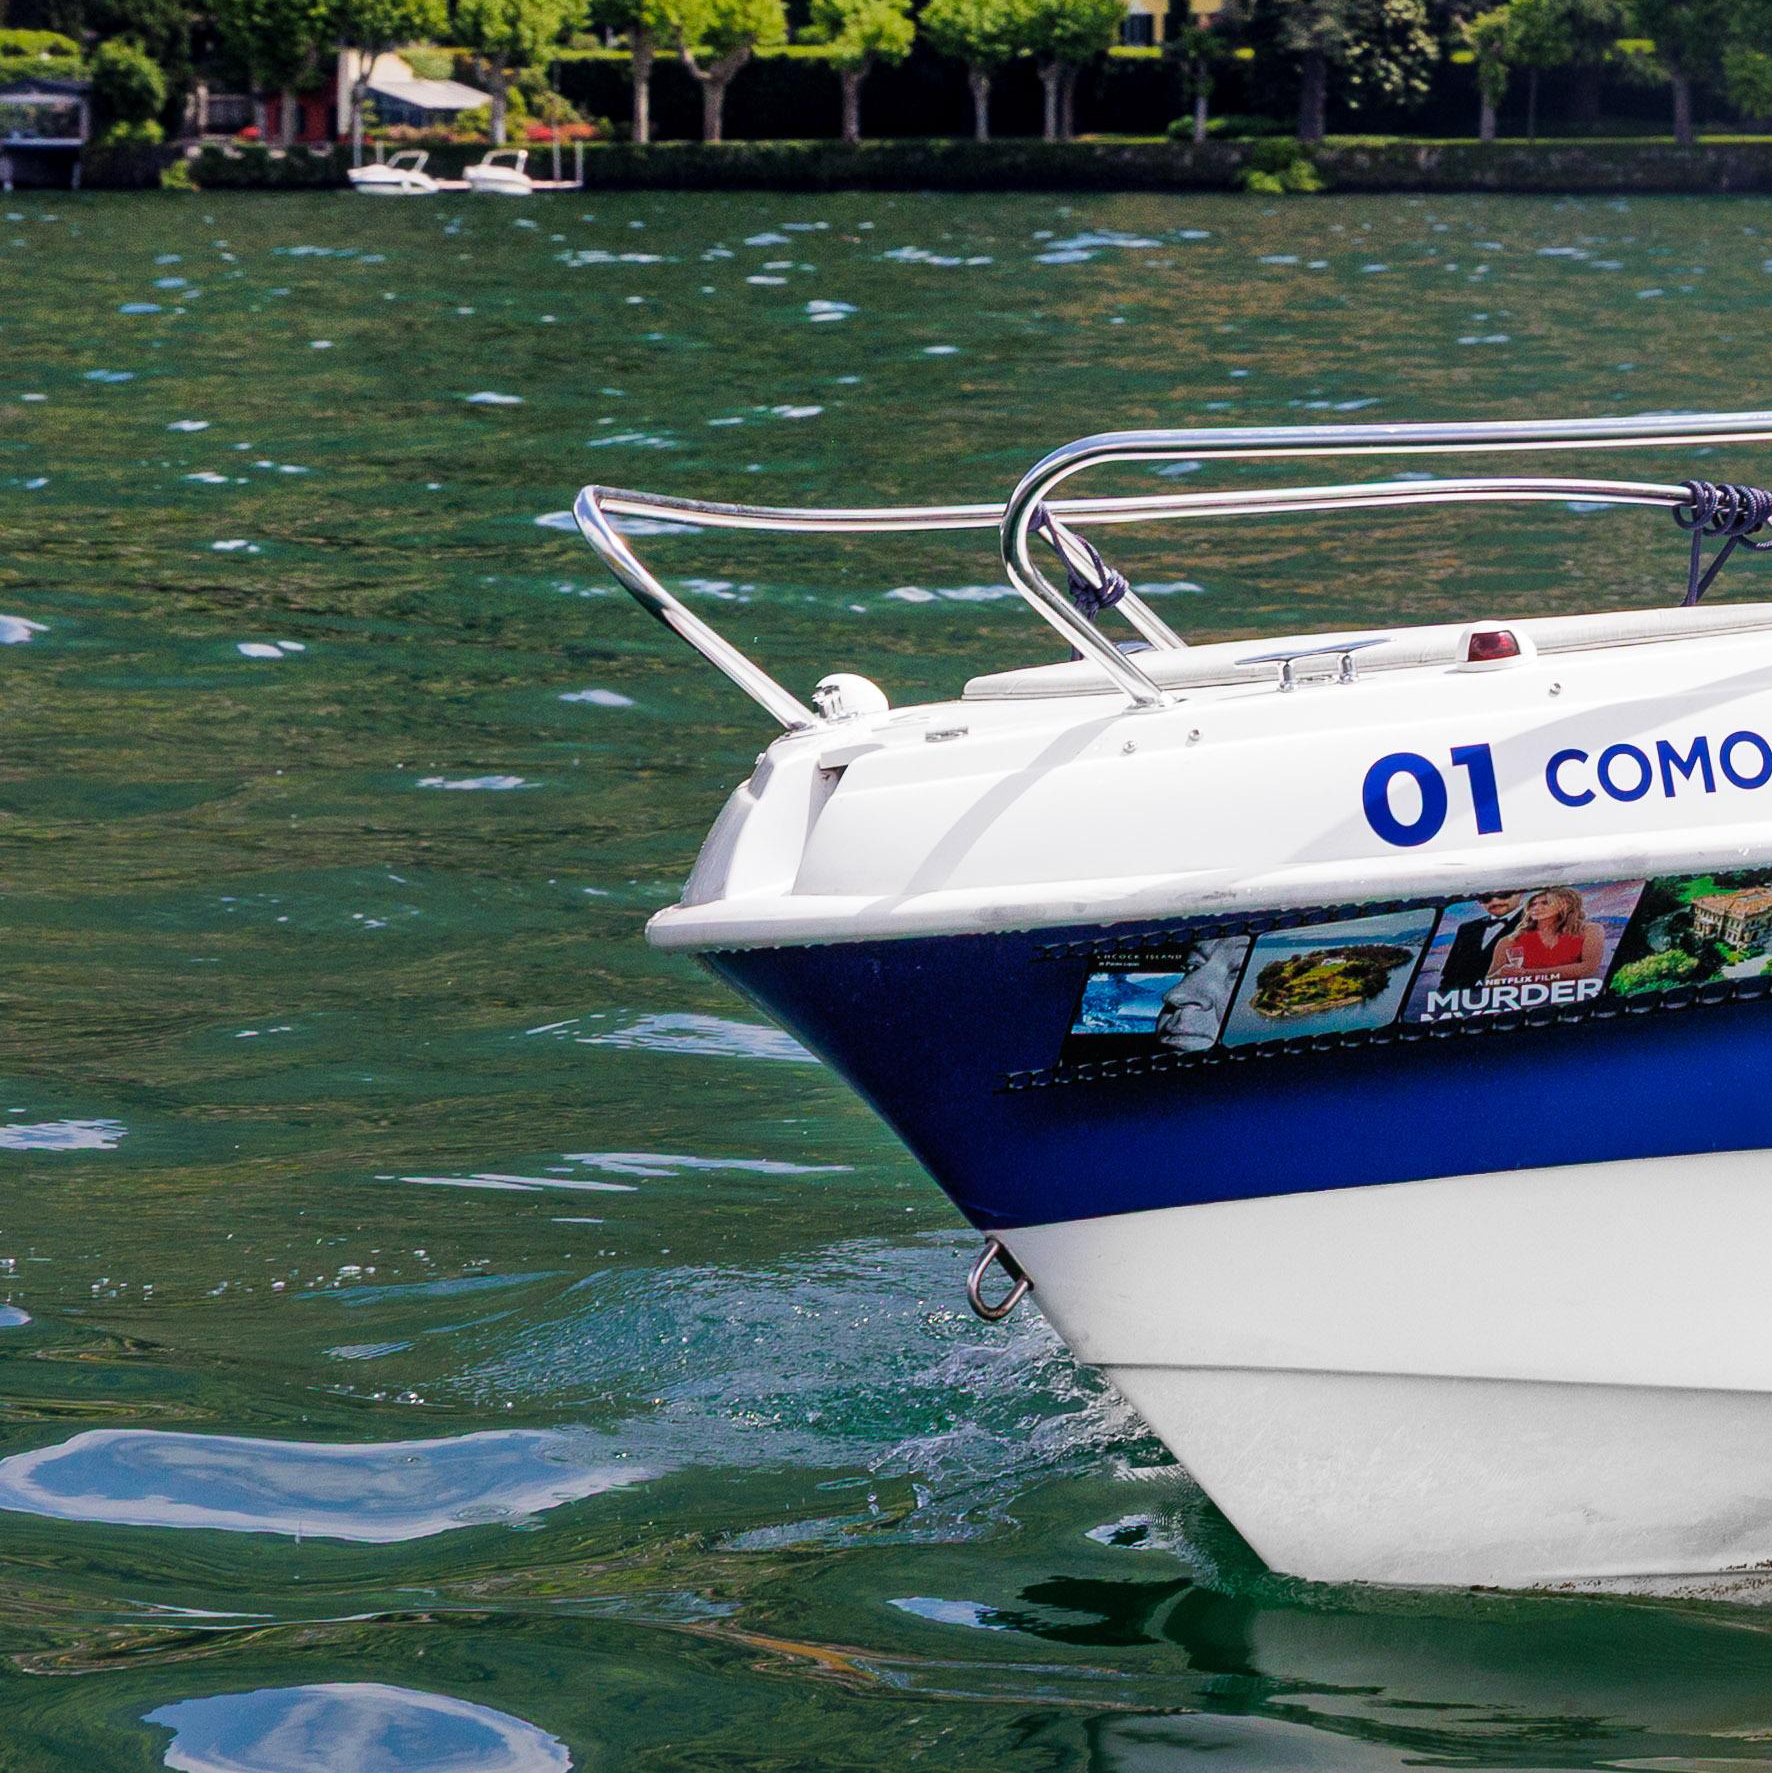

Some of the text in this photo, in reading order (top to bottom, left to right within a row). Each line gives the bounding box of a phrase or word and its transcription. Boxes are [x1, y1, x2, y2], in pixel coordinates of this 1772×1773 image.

[1361, 742, 1504, 847] 01
[1427, 978, 1603, 1013] MURDER
[1485, 975, 1532, 986] NETFLIX
[1535, 972, 1561, 981] FILM
